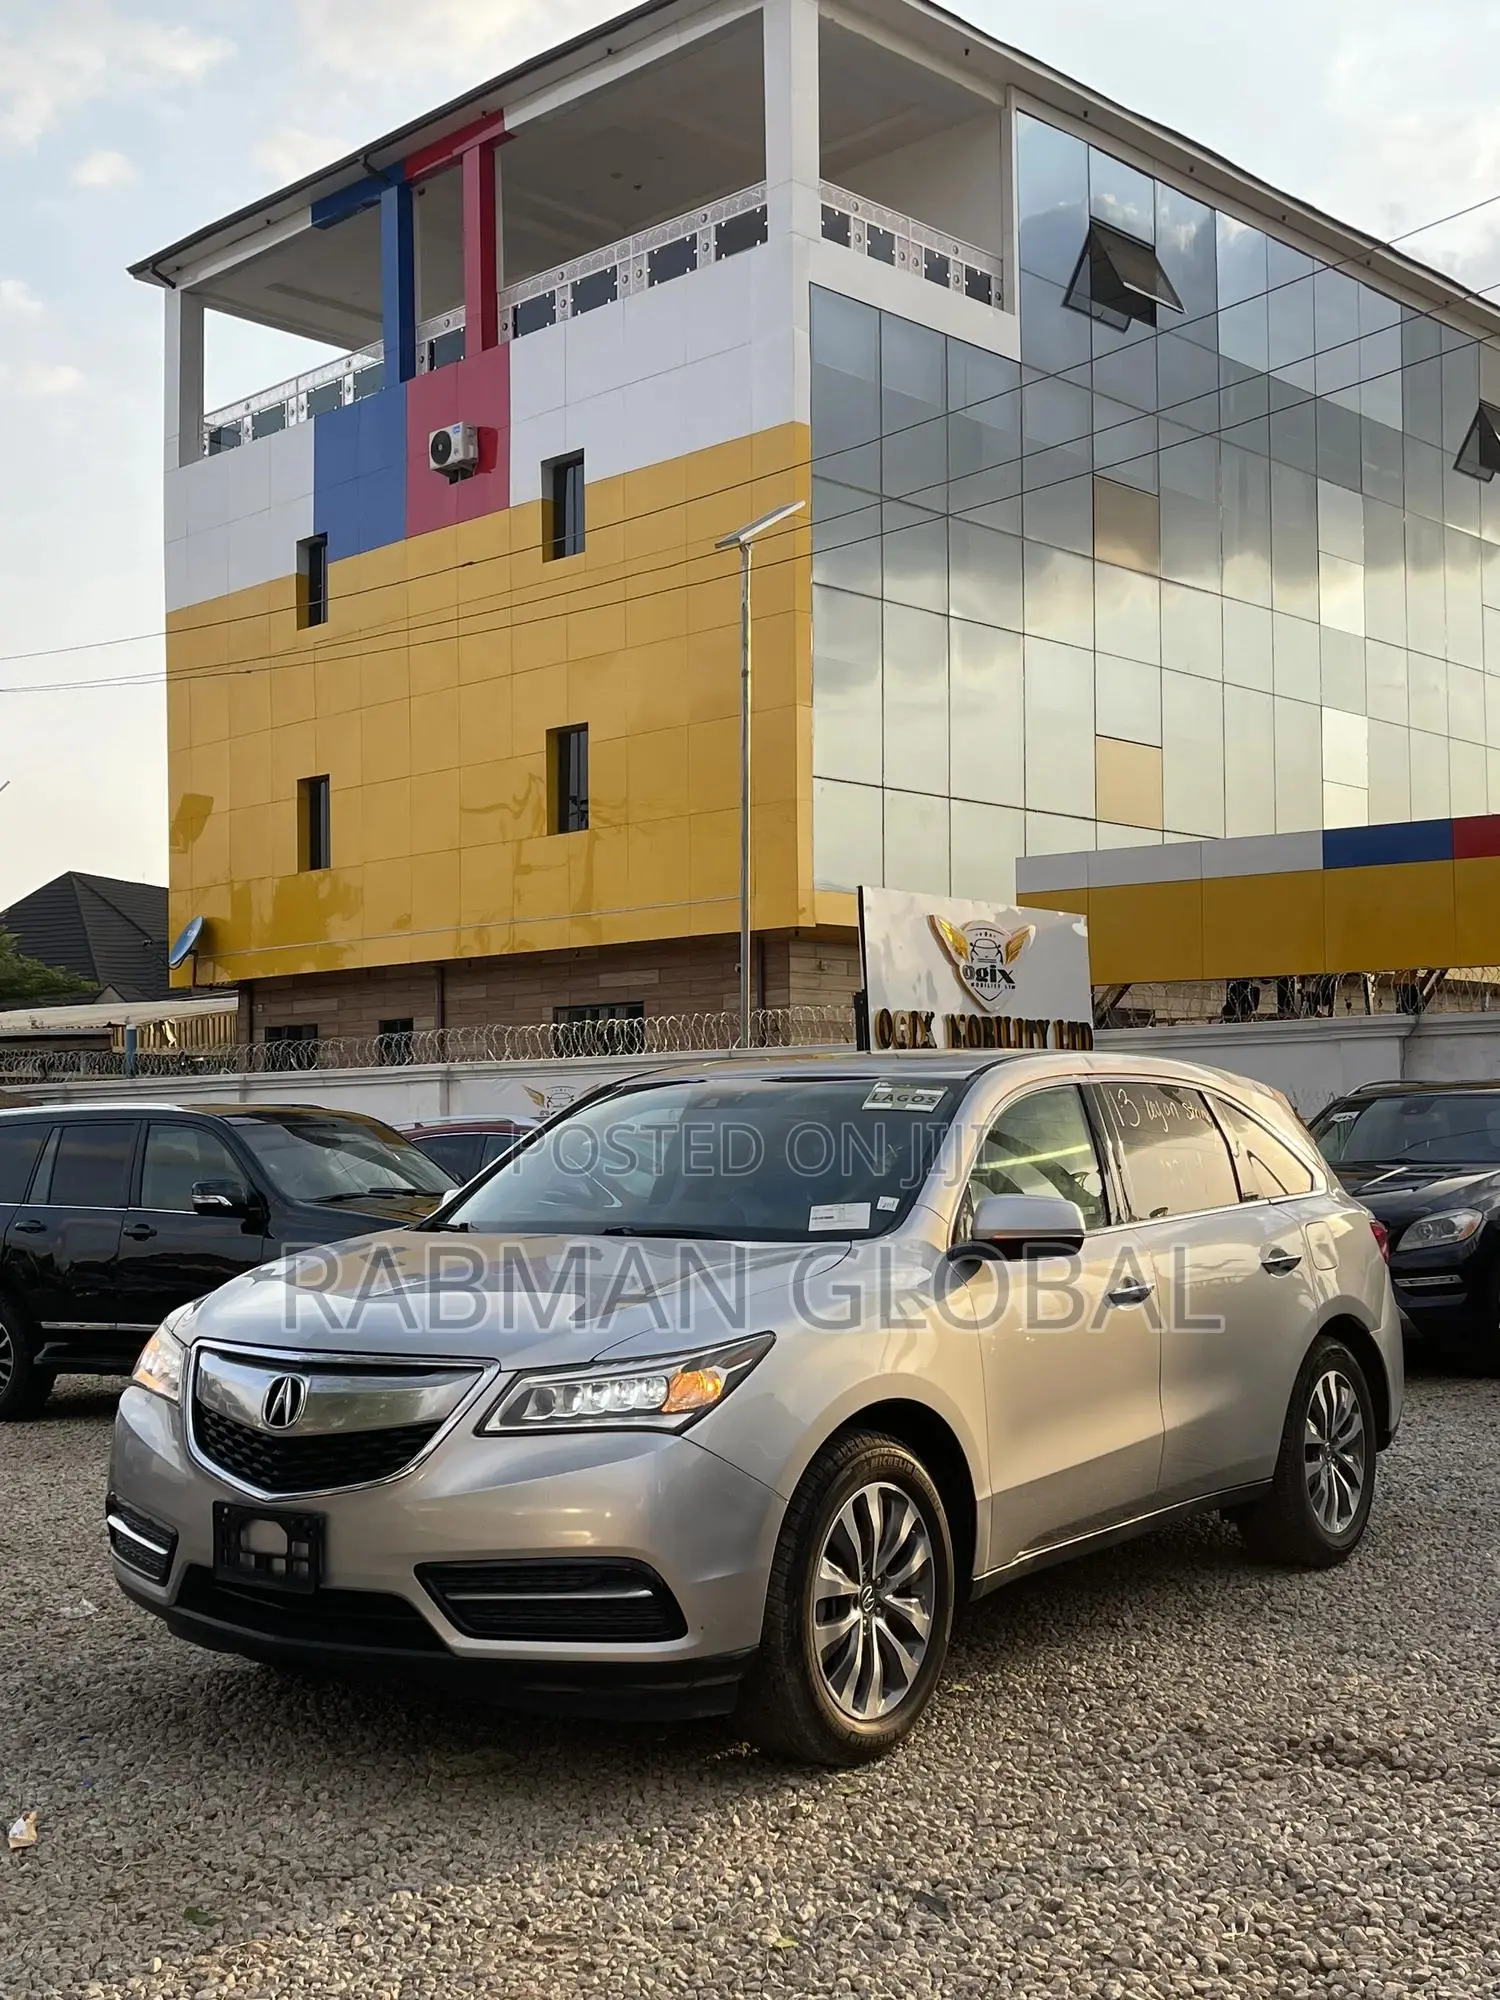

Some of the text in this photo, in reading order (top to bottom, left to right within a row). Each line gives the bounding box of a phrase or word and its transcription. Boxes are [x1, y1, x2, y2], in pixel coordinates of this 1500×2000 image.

[962, 964, 1016, 984] Ogix
[871, 1092, 938, 1104] LAGOS
[870, 1455, 915, 1474] MICHELIN
